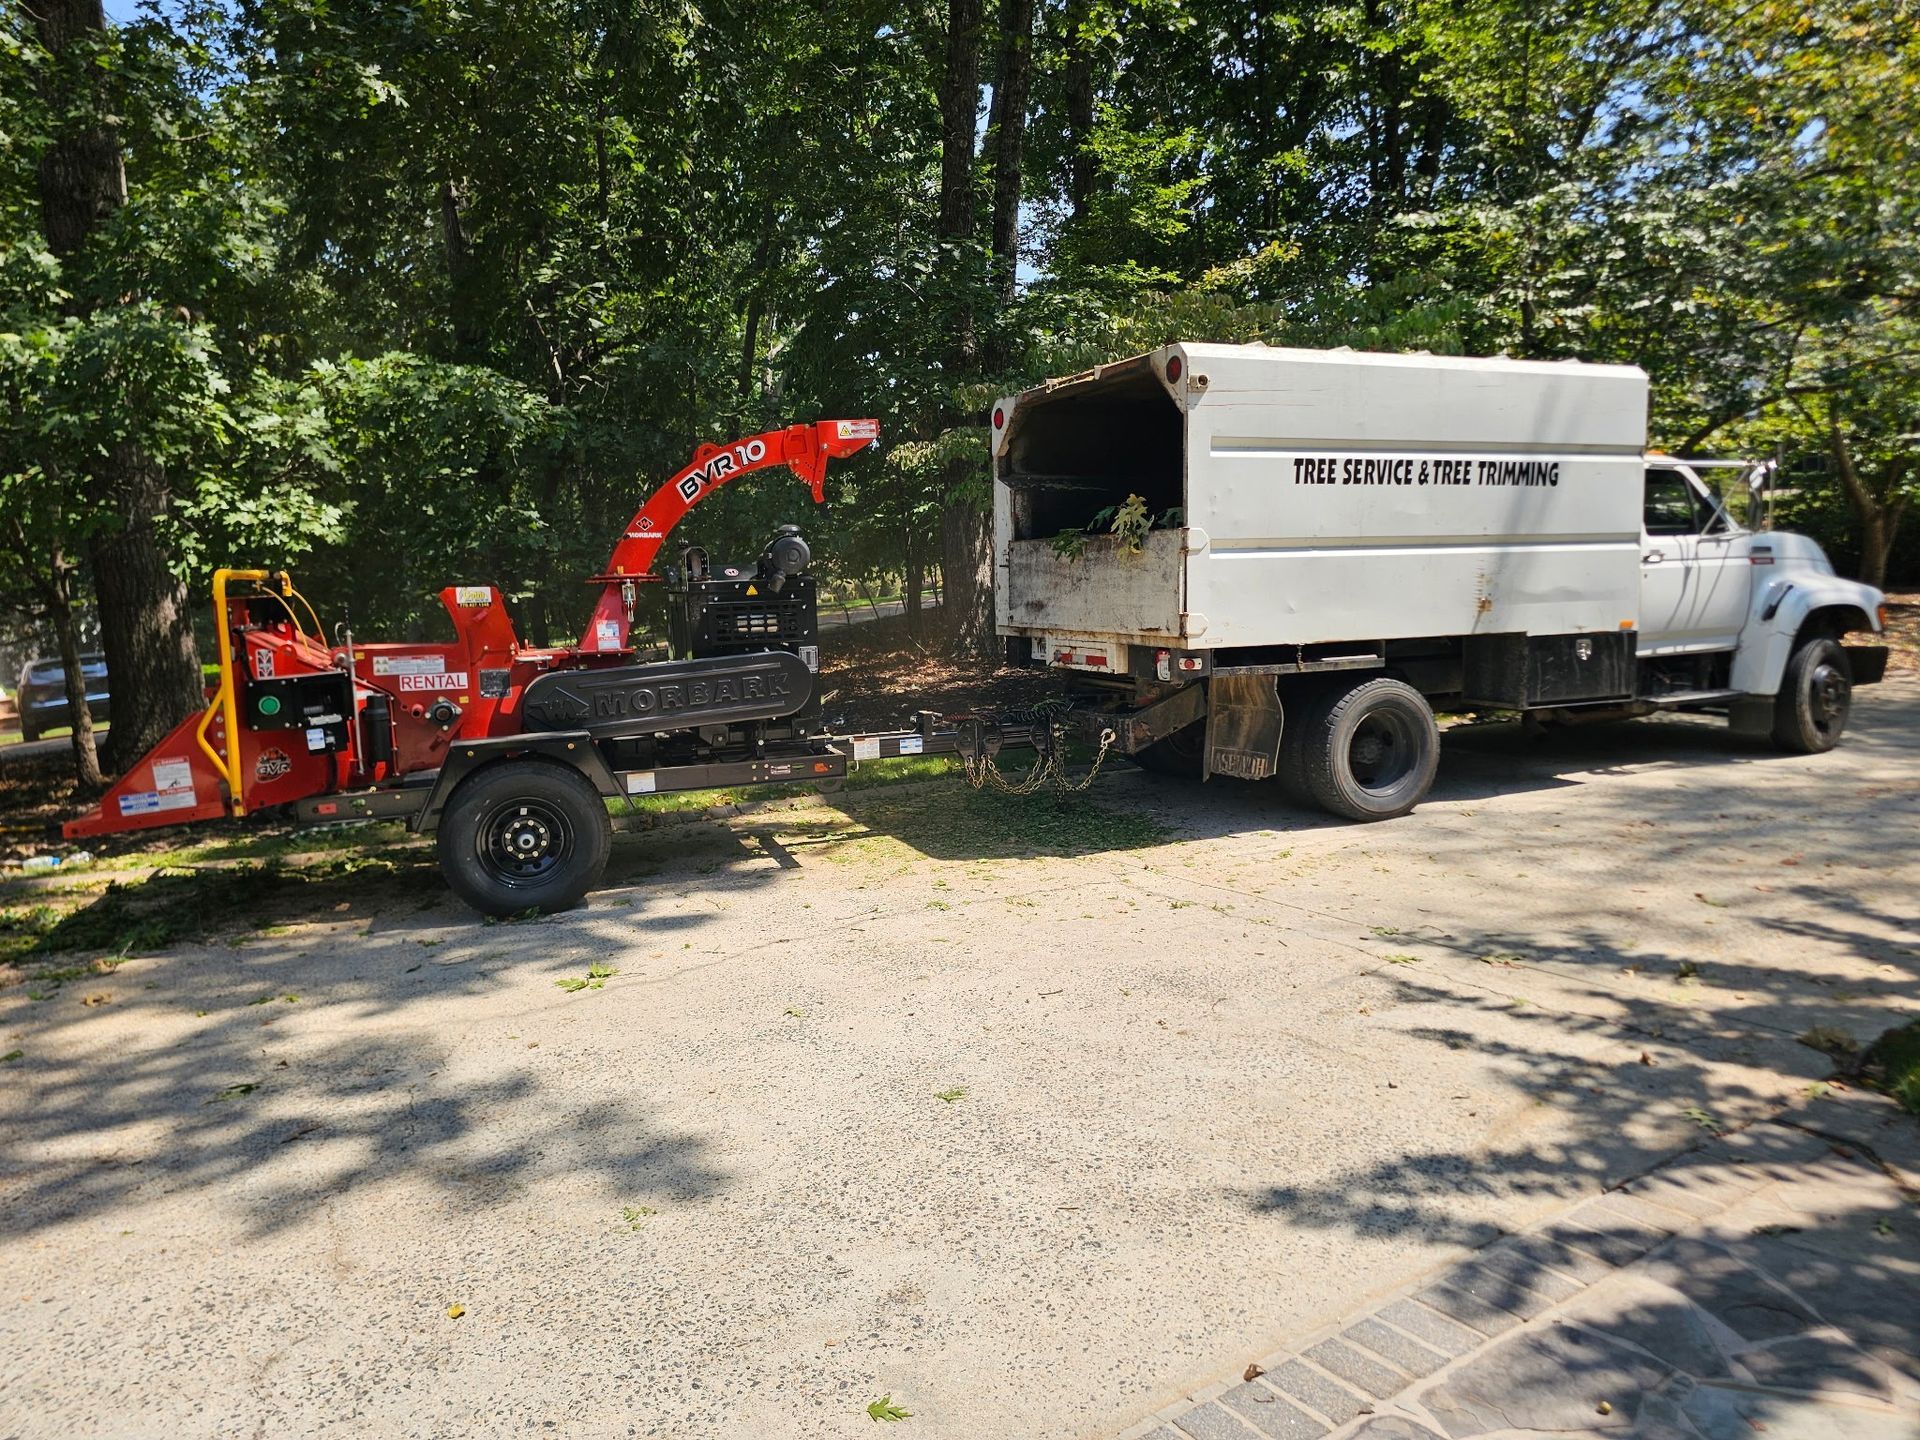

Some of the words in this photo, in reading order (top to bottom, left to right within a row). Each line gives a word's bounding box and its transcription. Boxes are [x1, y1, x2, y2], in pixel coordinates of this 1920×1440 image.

[677, 453, 738, 502] BVR
[735, 439, 766, 467] 10
[1293, 457, 1337, 485] TREE
[1342, 458, 1413, 486] SERVICE
[1418, 460, 1429, 486] &
[1433, 460, 1472, 486] TREE
[1478, 460, 1560, 487] TRIMMING
[401, 674, 466, 690] RENTAL
[594, 672, 791, 717] MORBARK
